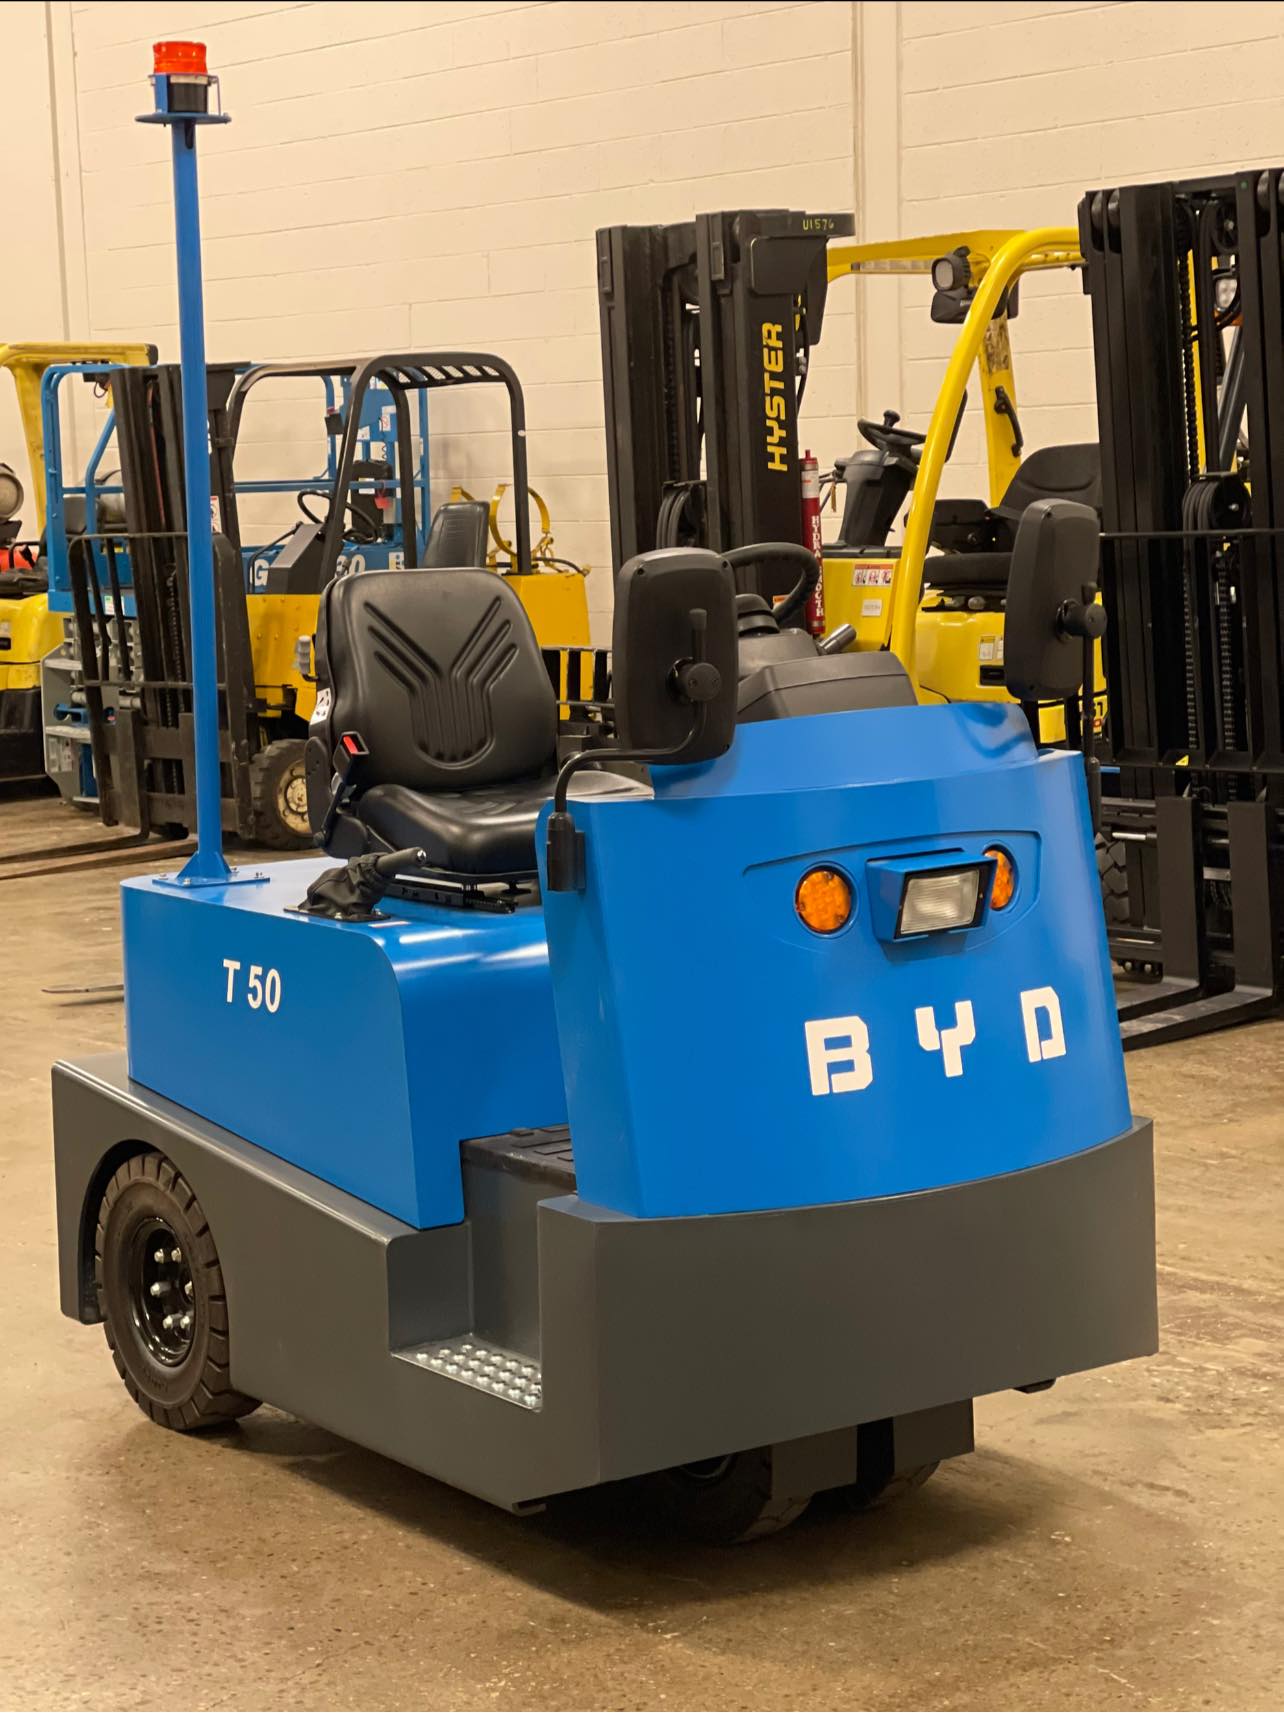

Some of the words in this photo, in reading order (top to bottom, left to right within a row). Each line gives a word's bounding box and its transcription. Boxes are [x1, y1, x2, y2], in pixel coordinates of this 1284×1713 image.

[762, 322, 788, 472] HYSTER
[223, 958, 241, 1003] T
[247, 965, 281, 1013] 50
